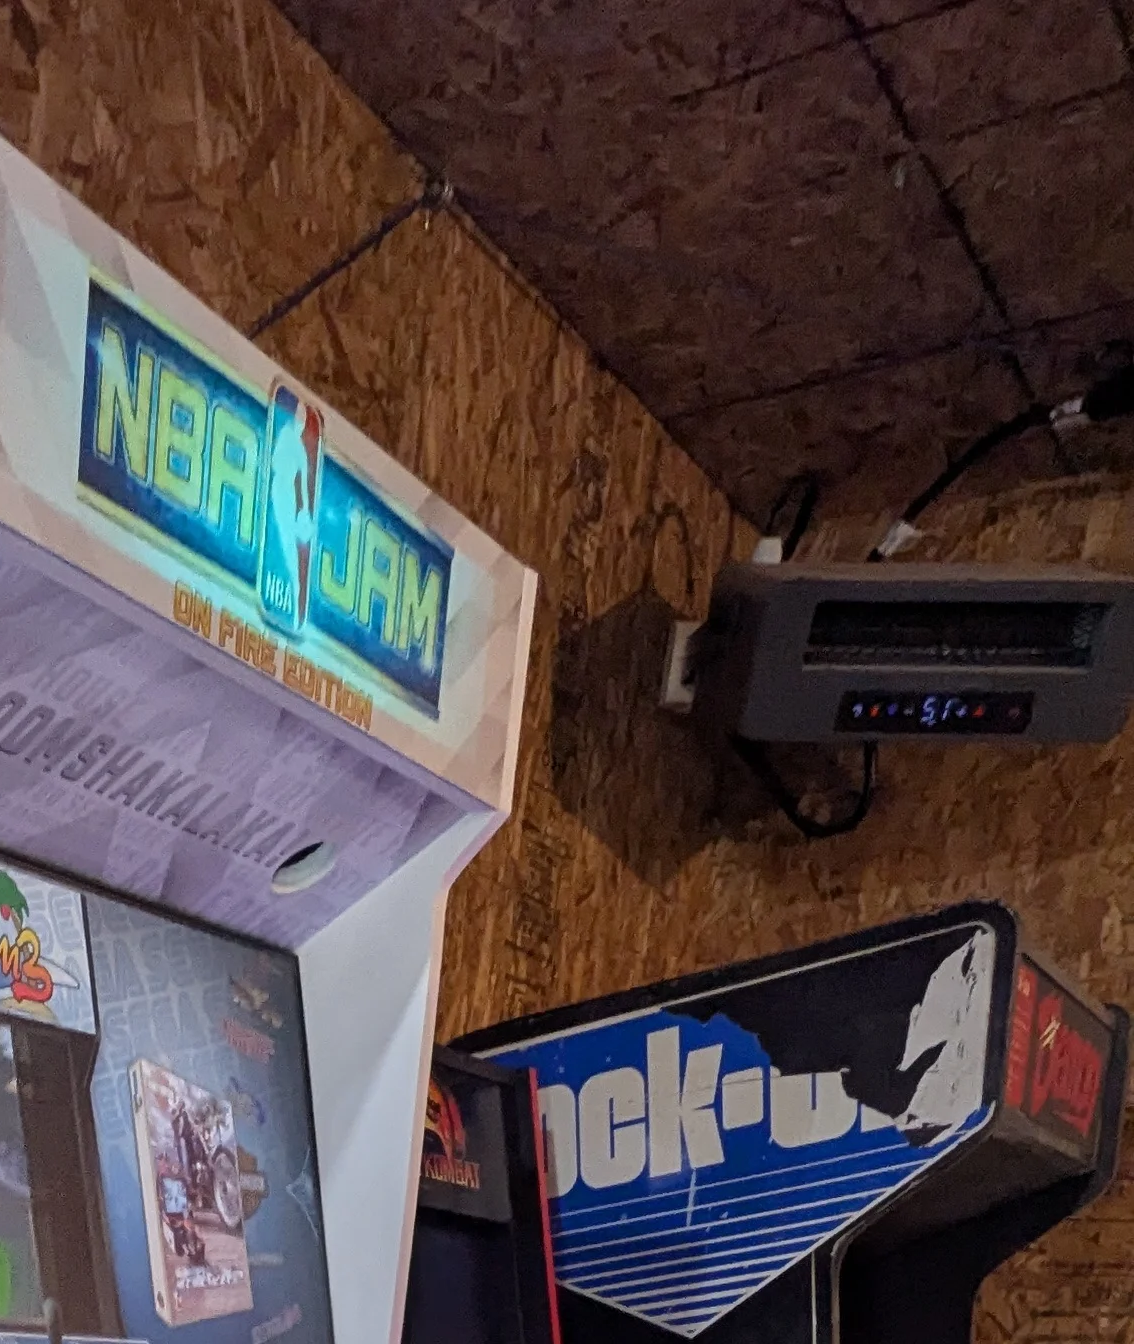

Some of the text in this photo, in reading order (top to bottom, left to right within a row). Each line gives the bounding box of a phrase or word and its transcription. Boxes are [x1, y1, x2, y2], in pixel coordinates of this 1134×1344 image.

[95, 322, 442, 677] NBA JAM
[172, 580, 373, 730] ON FIRE EDITION
[263, 570, 294, 616] NBA
[537, 1026, 898, 1200] ock-
